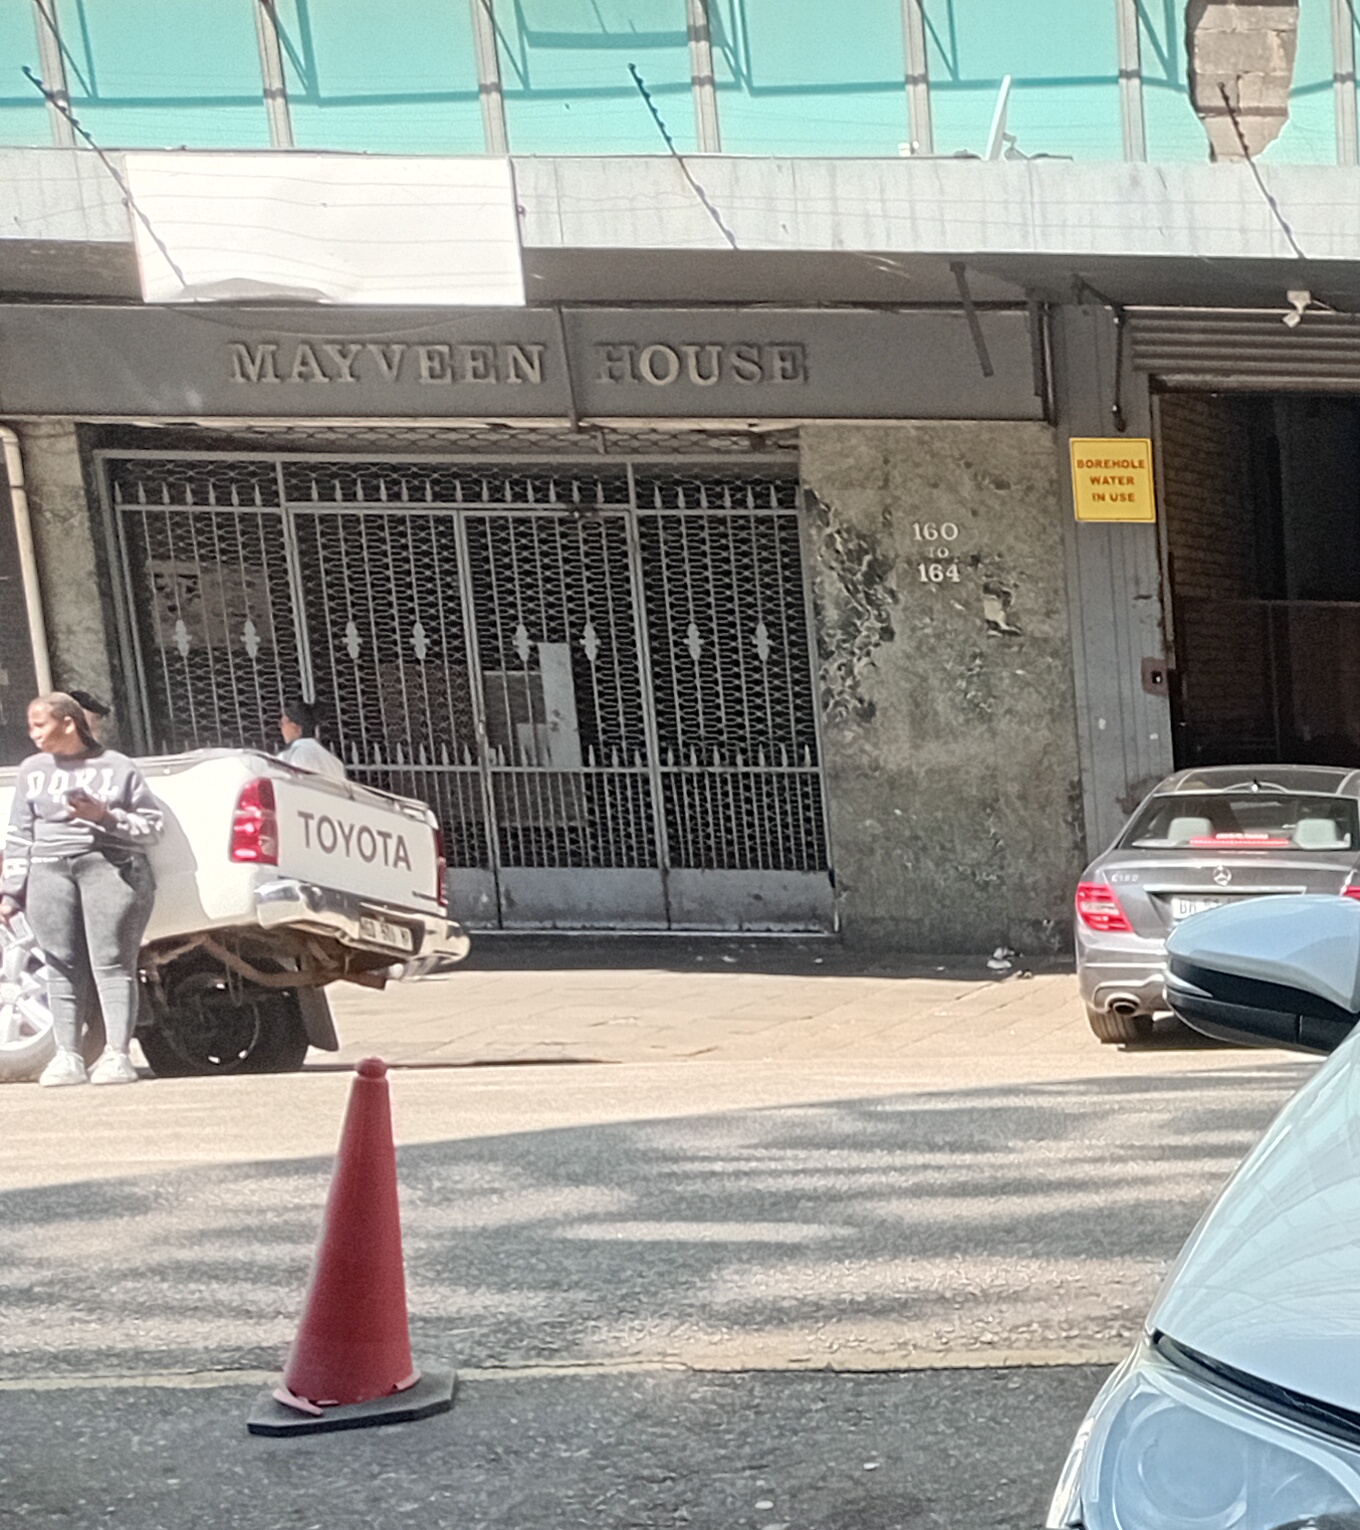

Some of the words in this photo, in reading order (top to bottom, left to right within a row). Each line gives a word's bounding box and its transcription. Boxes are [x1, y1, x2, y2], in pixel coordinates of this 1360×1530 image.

[230, 342, 546, 386] MAYVEEN
[596, 342, 808, 386] HOUSE
[1076, 459, 1145, 469] BOREHOLE
[1089, 476, 1135, 486] WATER
[1092, 493, 1105, 502] IN
[1109, 493, 1135, 502] USE
[912, 522, 959, 541] 160
[918, 563, 960, 582] 164
[297, 810, 412, 872] TOYOTA
